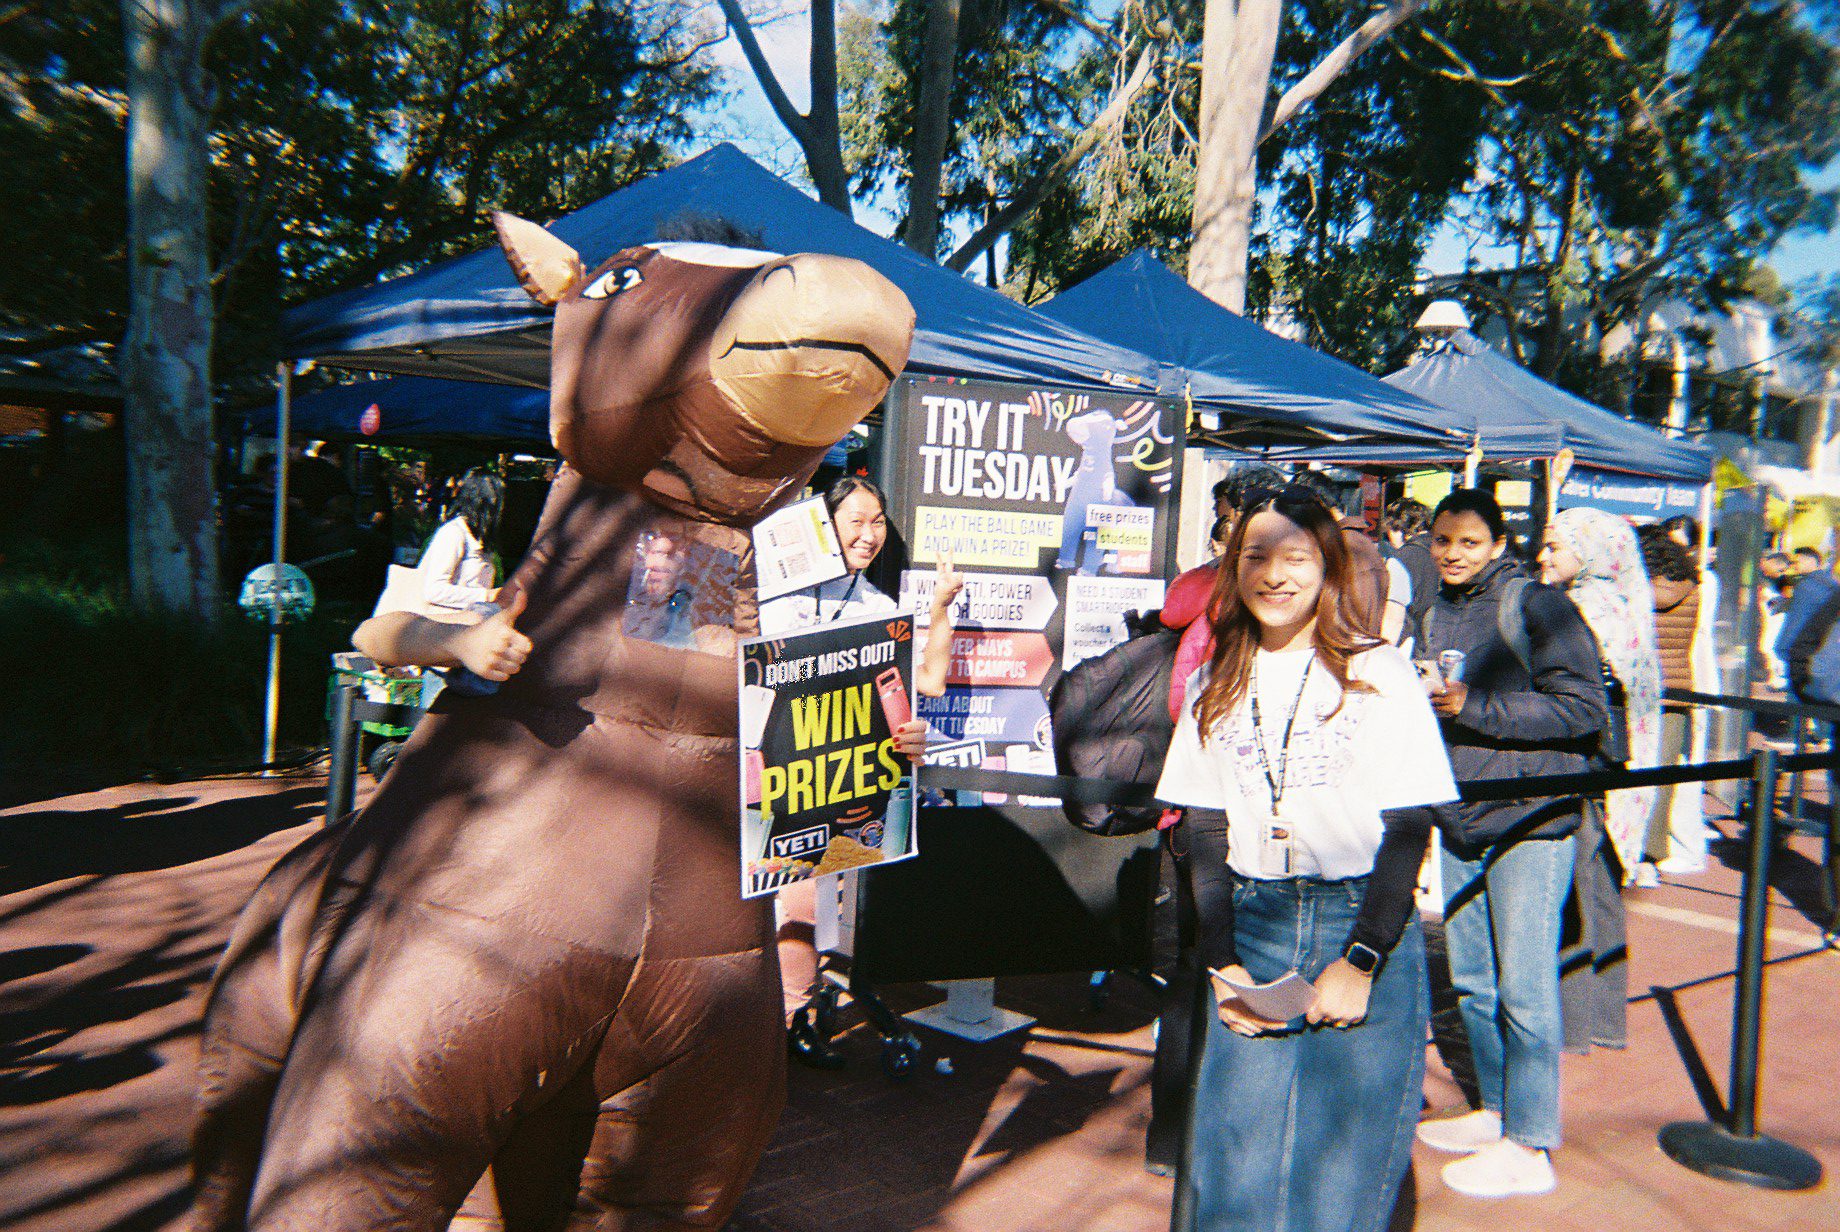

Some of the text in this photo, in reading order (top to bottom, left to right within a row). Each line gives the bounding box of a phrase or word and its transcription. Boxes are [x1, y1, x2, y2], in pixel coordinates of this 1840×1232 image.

[922, 395, 1031, 452] TRY IT
[919, 446, 1075, 503] TUESDAY
[925, 513, 1055, 537] PLAY THE BALL GAME
[1090, 509, 1150, 525] free prizes
[924, 535, 1031, 556] AND WIN A PRIZE!
[1100, 531, 1149, 546] students
[990, 582, 1033, 600] POWER
[1109, 586, 1148, 600] STUDENT
[953, 601, 970, 619] OR
[973, 602, 1024, 621] GOODIES
[976, 638, 1013, 656] WAYS
[765, 656, 816, 687] DON'T
[818, 647, 858, 676] MISS
[860, 640, 896, 667] OUT!
[956, 659, 973, 677] TO
[975, 660, 1028, 679] CAMPUS
[917, 695, 994, 714] EARN ABOUT
[791, 683, 872, 751] WIN
[935, 716, 947, 734] IT
[949, 716, 1006, 735] TUESDAY
[922, 744, 981, 768] YETI
[761, 738, 902, 820] PRIZES
[775, 830, 825, 856] YETI
